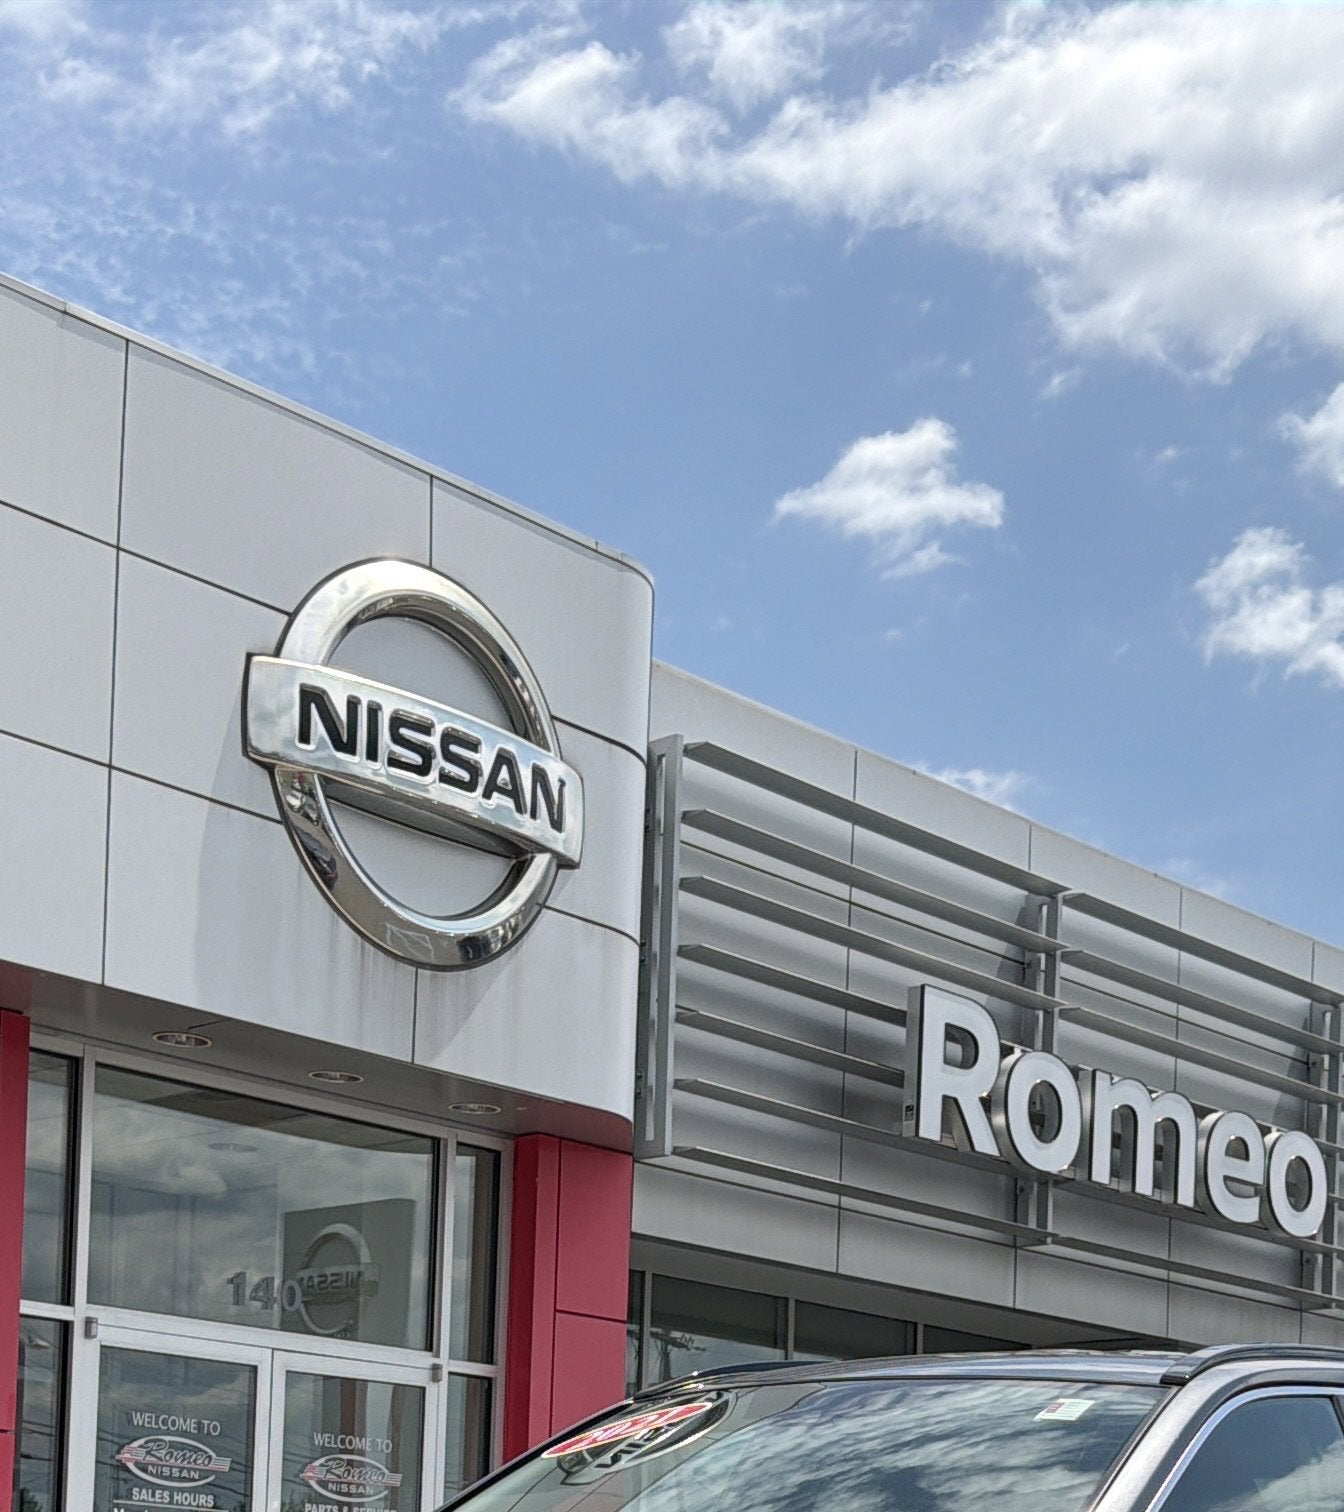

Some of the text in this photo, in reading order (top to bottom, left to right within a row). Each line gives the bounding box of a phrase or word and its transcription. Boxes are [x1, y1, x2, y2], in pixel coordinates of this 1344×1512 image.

[296, 683, 566, 833] NISSAN
[912, 984, 1328, 1238] Romeo
[226, 1271, 302, 1312] 140
[131, 1411, 221, 1436] WELCOME TO
[142, 1438, 213, 1467] Romeo
[314, 1432, 393, 1453] WELCOME TO
[147, 1465, 200, 1480] NISSAN
[321, 1457, 387, 1481] Romeo
[132, 1487, 215, 1508] SALES HOURS
[328, 1482, 374, 1495] NISSAN
